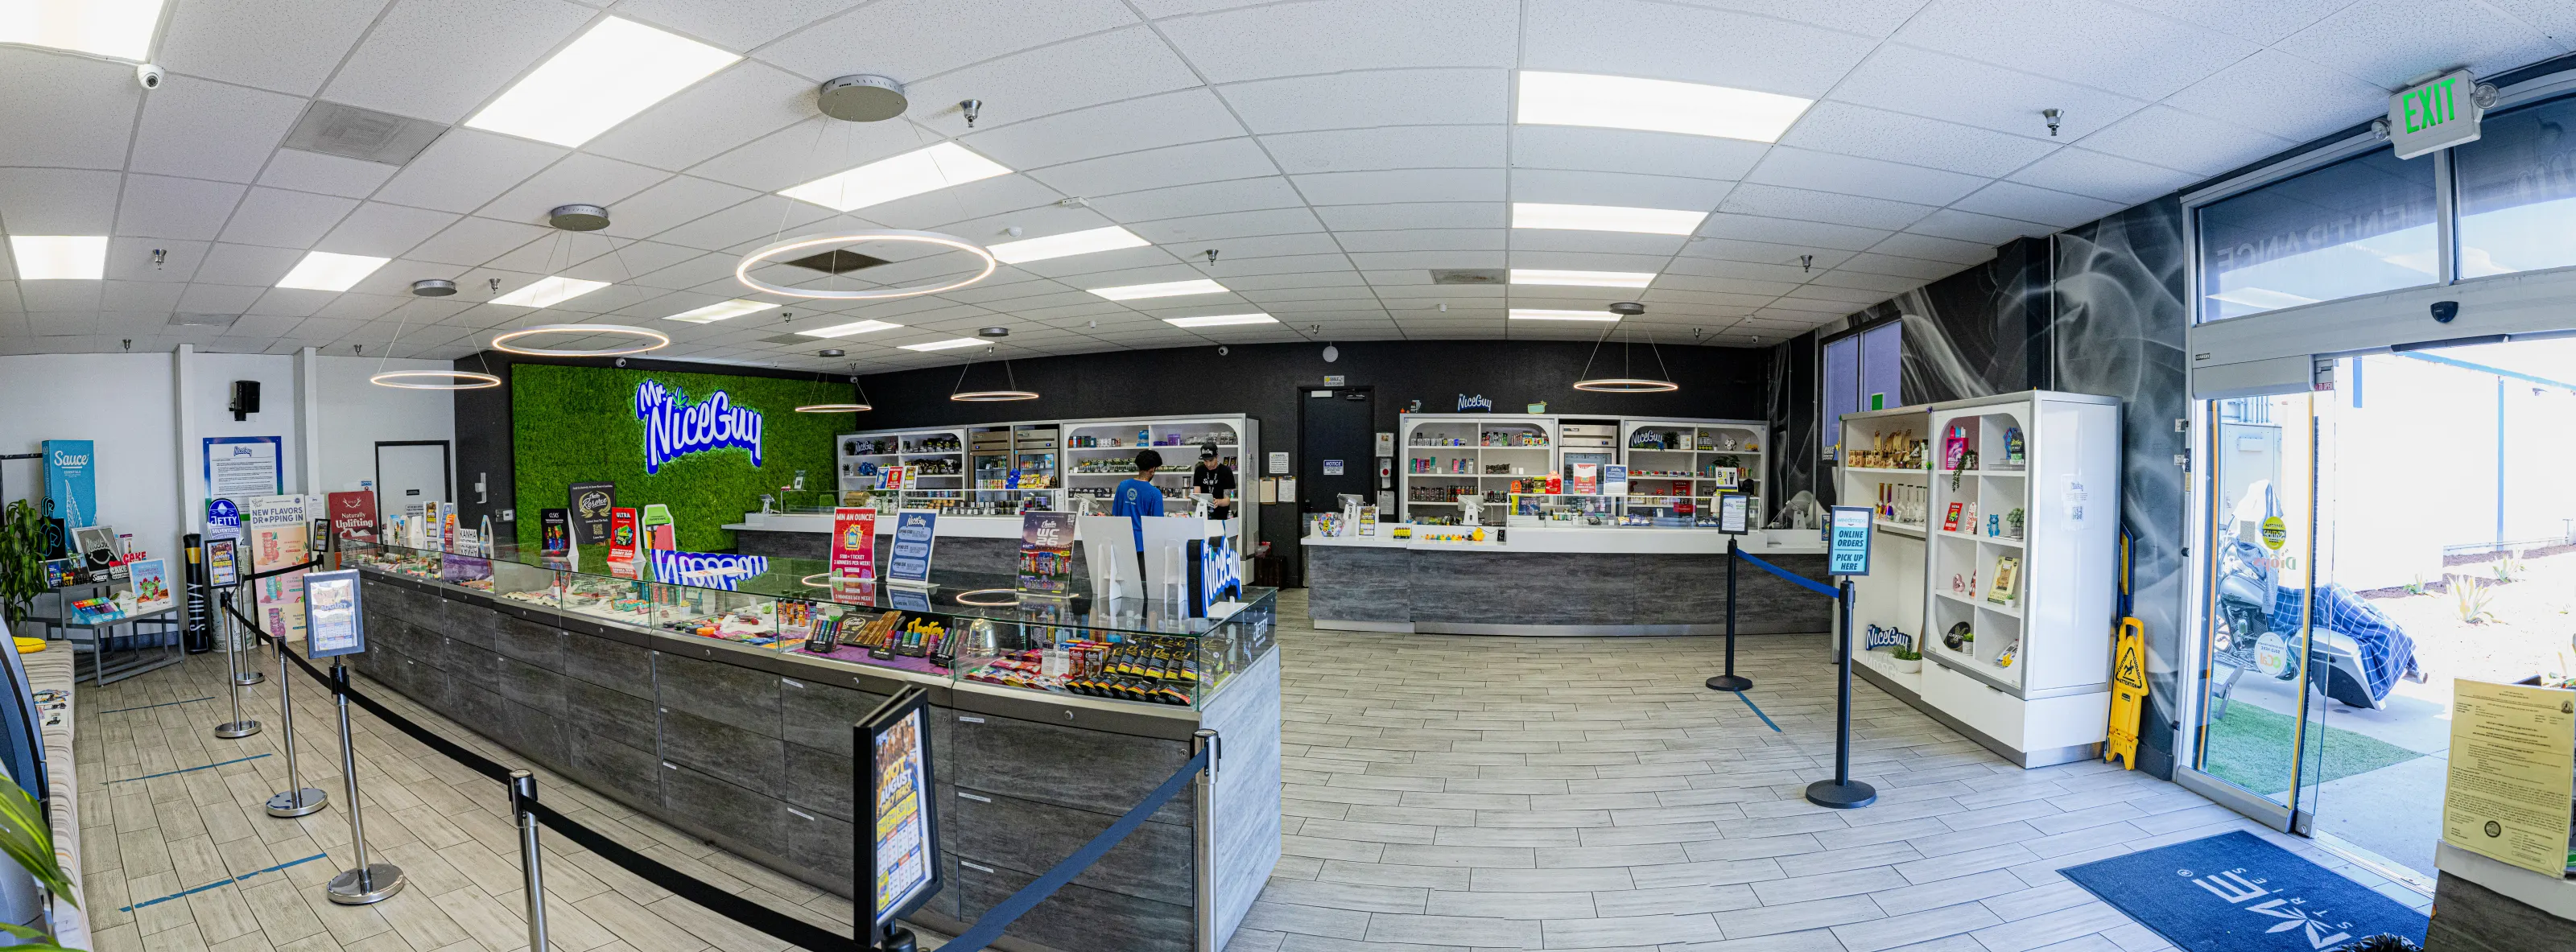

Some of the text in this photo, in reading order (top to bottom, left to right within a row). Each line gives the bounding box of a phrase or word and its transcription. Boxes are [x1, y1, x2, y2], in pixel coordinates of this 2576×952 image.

[2402, 77, 2456, 134] EXIT
[640, 379, 667, 412] Mr.
[1458, 394, 1492, 411] NiceGuy
[650, 391, 763, 467] NiceGuy
[54, 450, 89, 466] Sauce
[252, 506, 303, 517] NEW FLAVORS
[295, 513, 303, 521] IN
[836, 513, 846, 521] WIN
[855, 513, 874, 521] OUNCE!
[211, 514, 238, 525] JETTY
[336, 518, 374, 529] Uplifting
[1839, 530, 1864, 538] ONLINE
[1035, 537, 1059, 546] 26
[1838, 539, 1864, 547] ORDERS
[122, 551, 147, 564] CAKE
[1836, 554, 1864, 562] PICK UP
[109, 566, 129, 575] CAKE
[1203, 538, 1242, 612] NiceGuy
[93, 574, 108, 582] Sauce
[320, 603, 348, 611] AUGUST
[1866, 628, 1909, 650] NiceGuy
[2117, 653, 2128, 673] CAUTION
[2133, 657, 2141, 680] CUIDADO
[2119, 678, 2137, 689] ATTENTION
[883, 755, 907, 785] HOT
[880, 769, 913, 808] AUGUST
[2231, 868, 2354, 929] STRIES
[2191, 870, 2353, 950] ME
